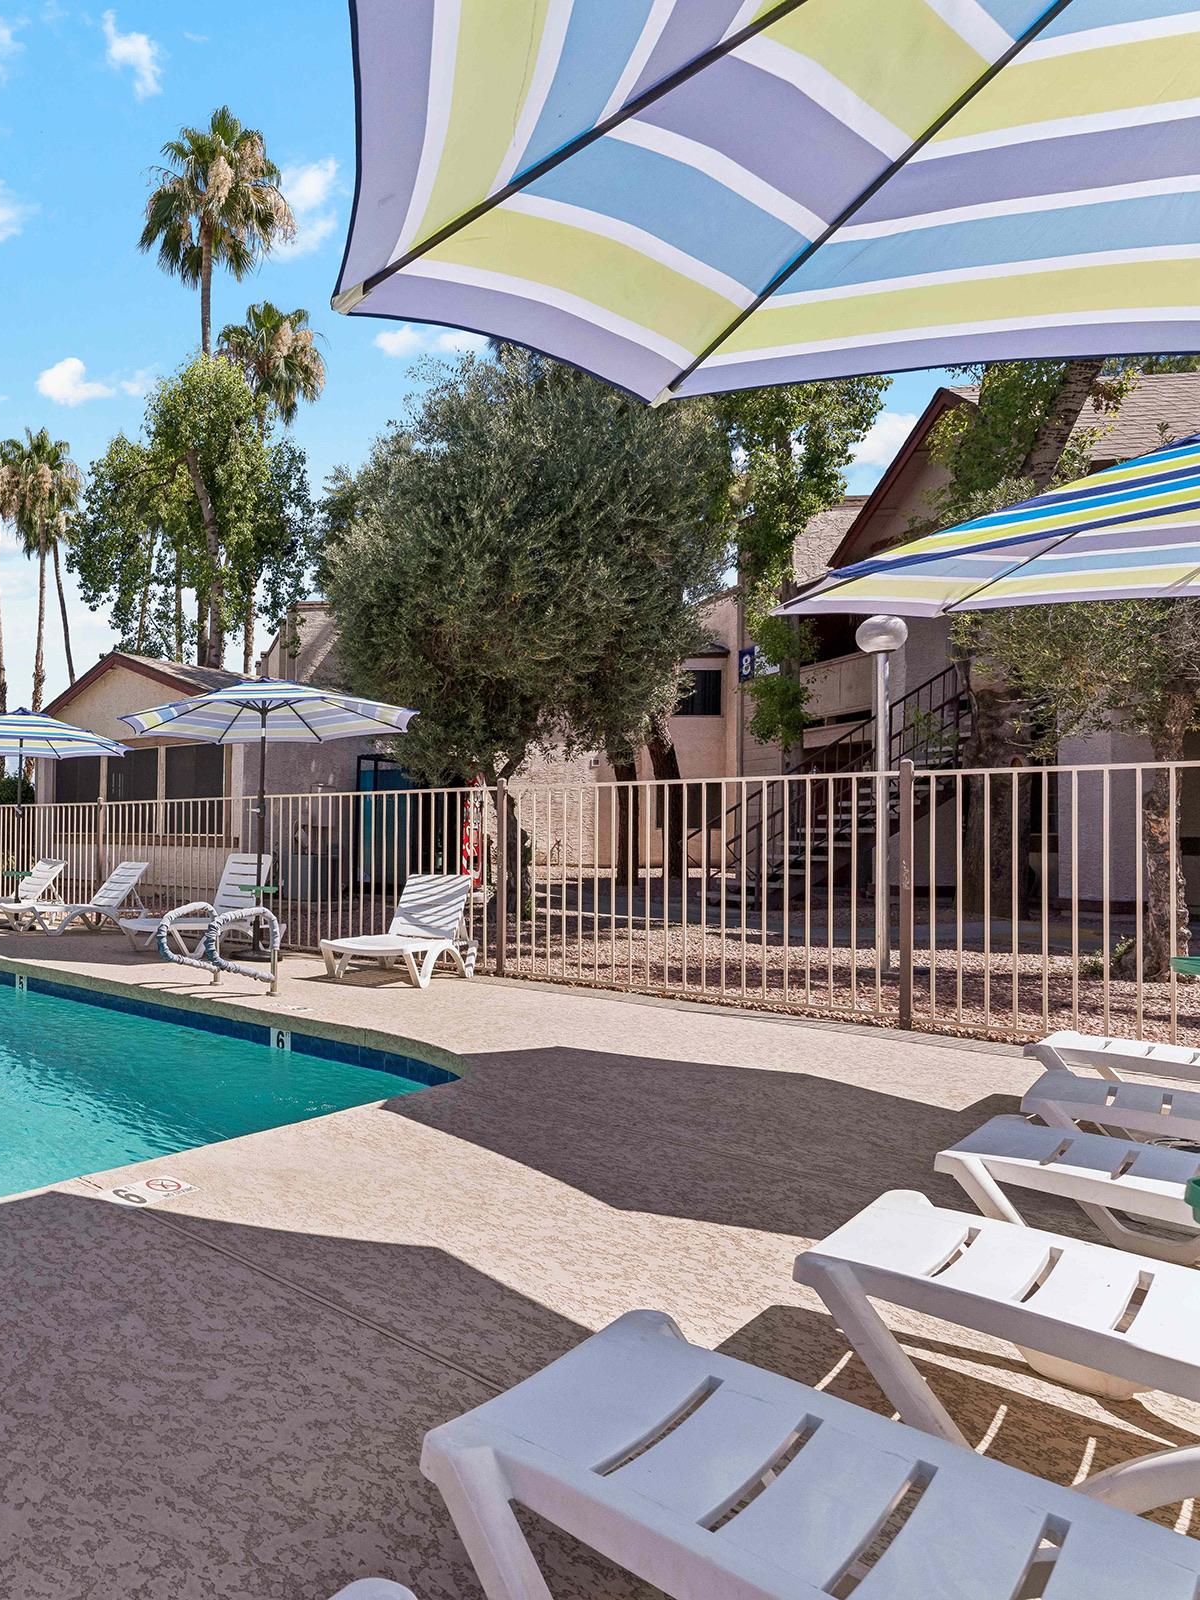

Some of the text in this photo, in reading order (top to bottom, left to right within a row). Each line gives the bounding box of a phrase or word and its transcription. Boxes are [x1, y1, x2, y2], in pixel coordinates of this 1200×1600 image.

[742, 654, 751, 675] 8
[276, 1030, 285, 1049] 6
[113, 1189, 148, 1204] 6
